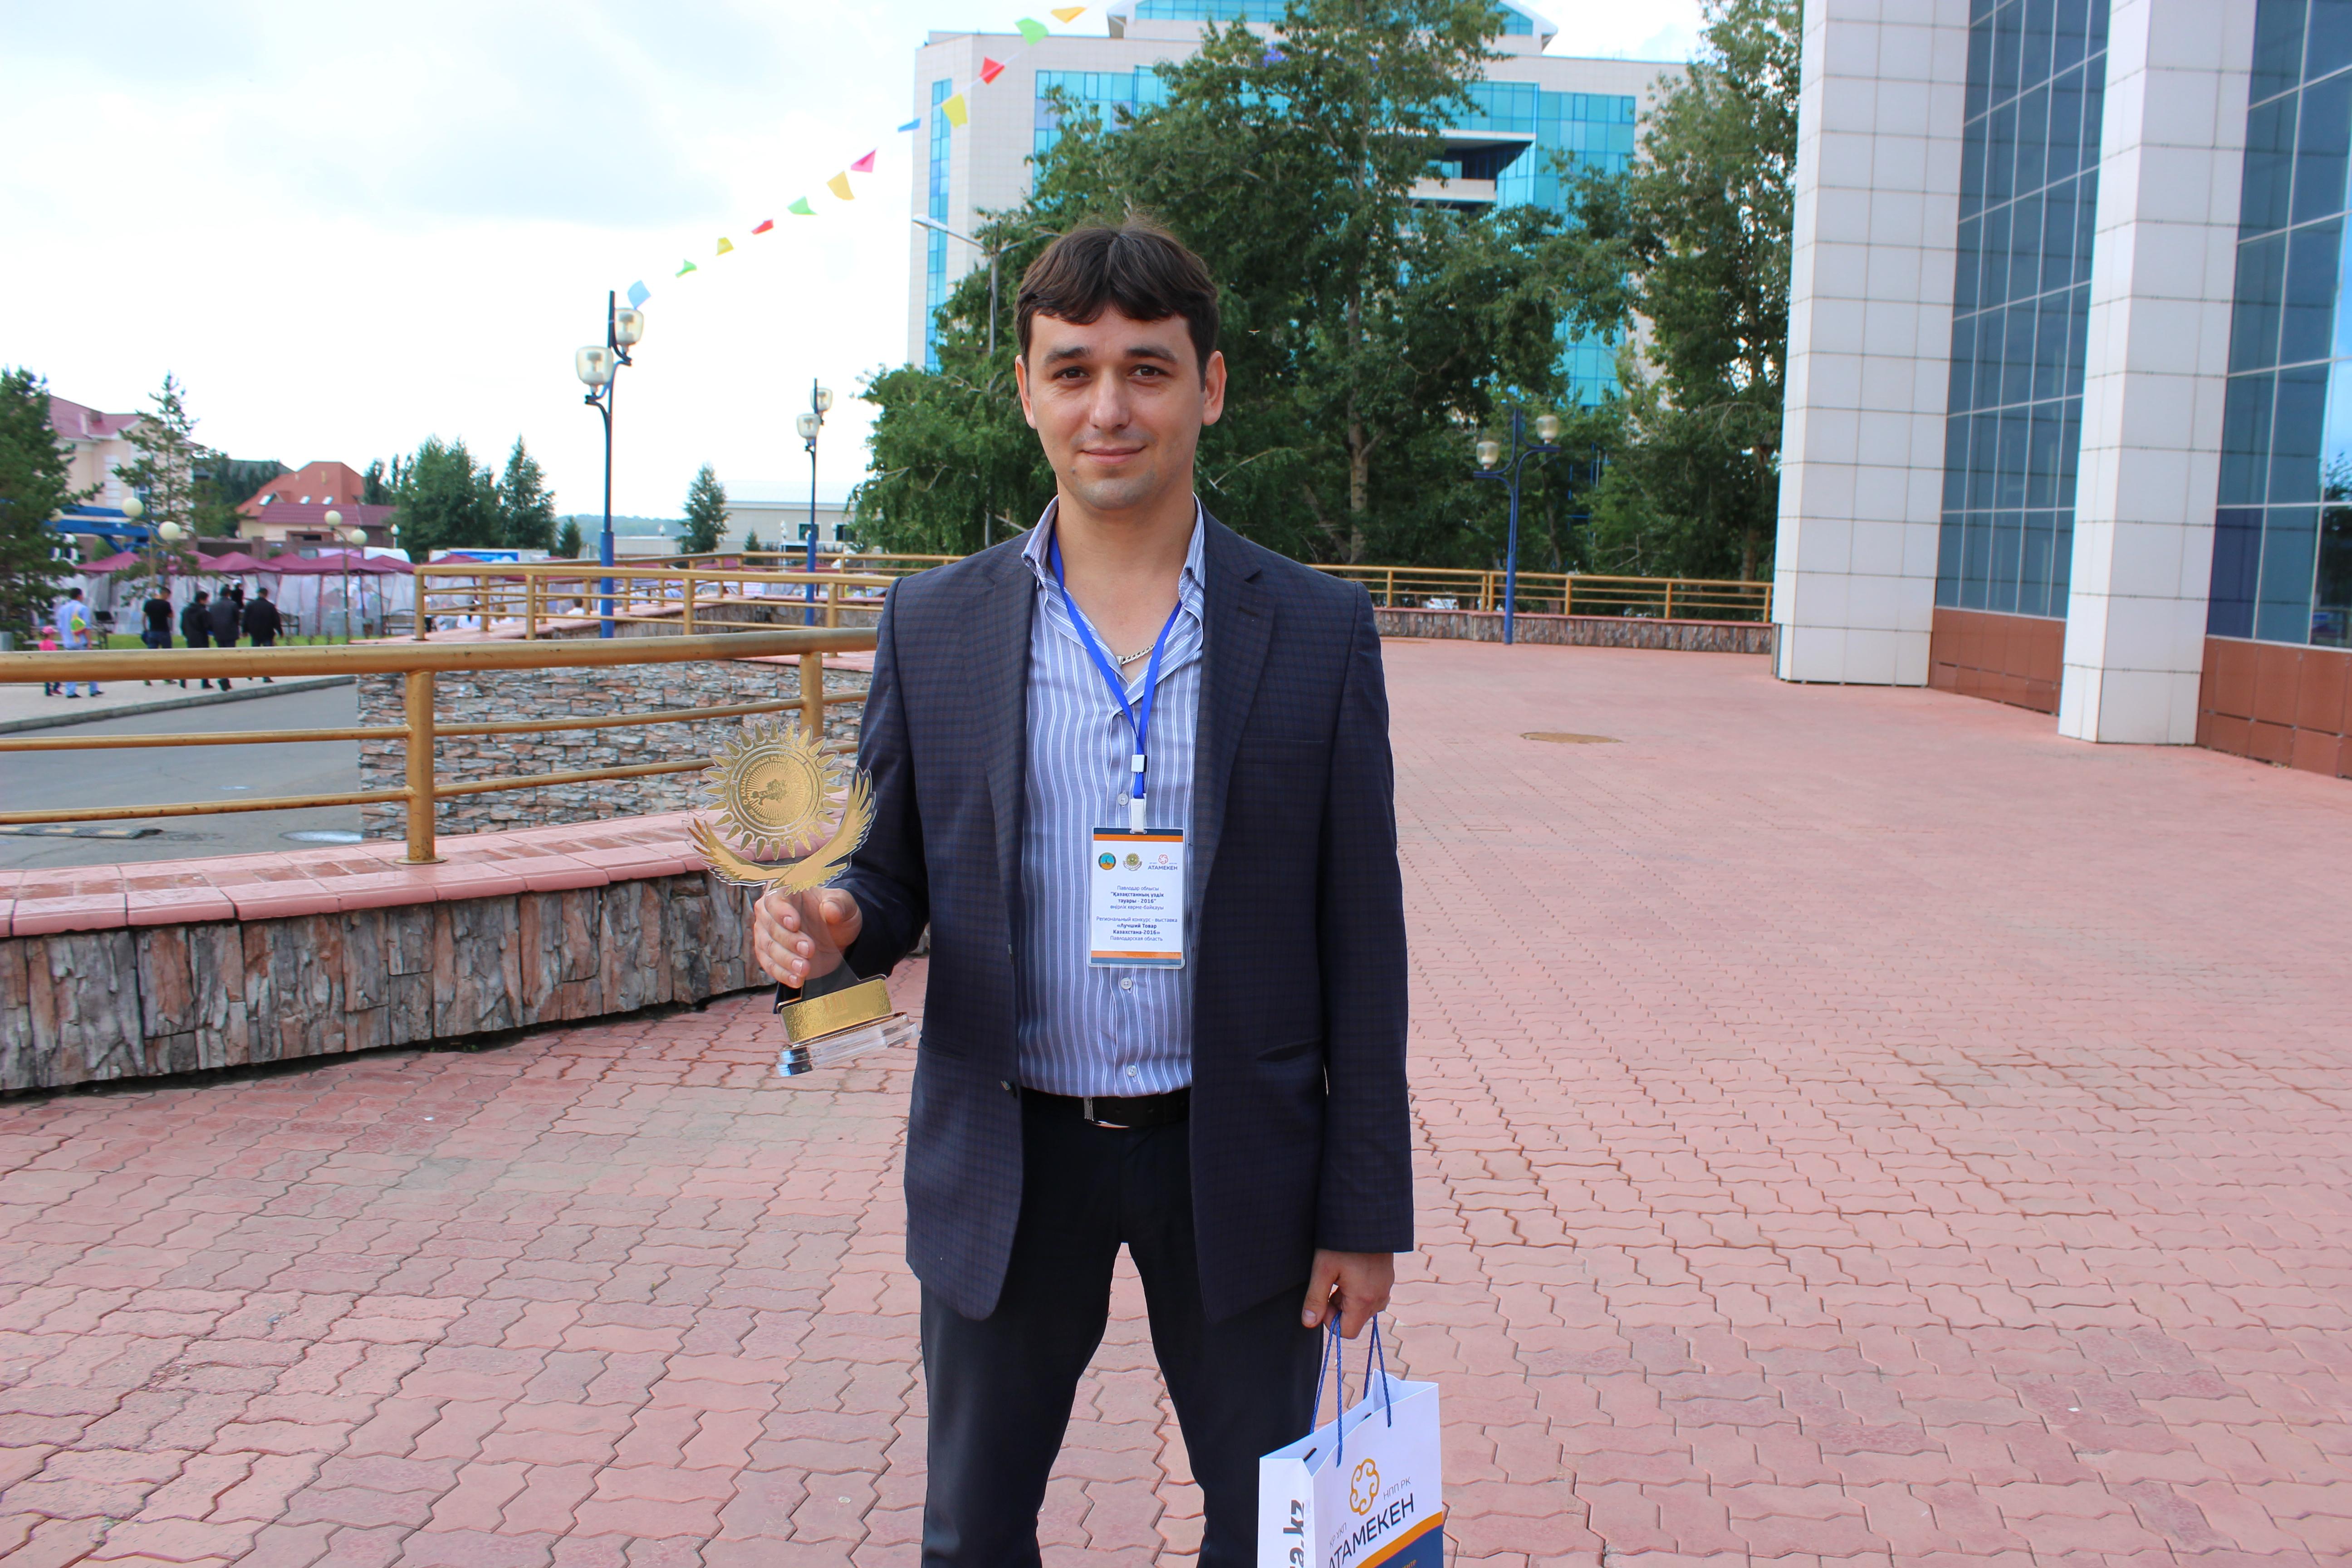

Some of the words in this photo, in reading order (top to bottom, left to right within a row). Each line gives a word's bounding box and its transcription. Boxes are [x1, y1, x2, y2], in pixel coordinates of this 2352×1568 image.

[1383, 1483, 1399, 1500] НПП
[1401, 1476, 1411, 1490] РК
[1283, 1499, 1305, 1568] a.kz
